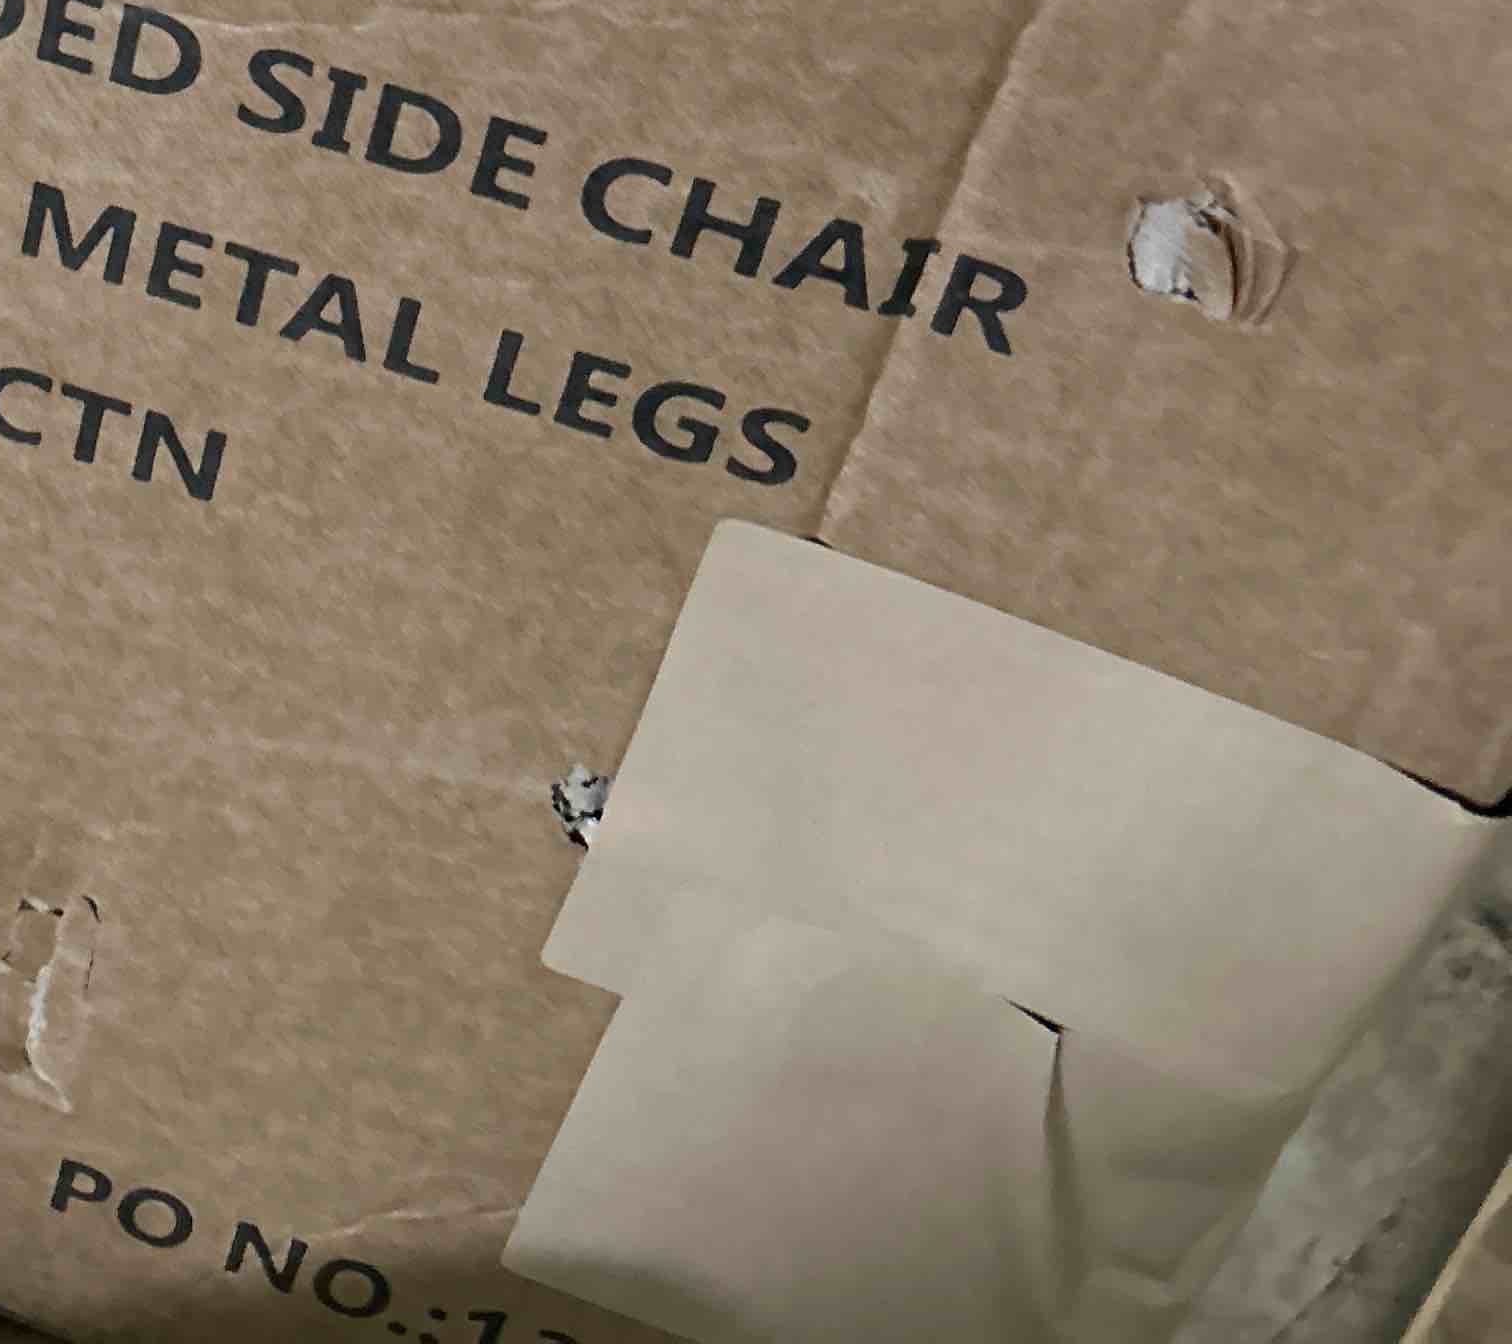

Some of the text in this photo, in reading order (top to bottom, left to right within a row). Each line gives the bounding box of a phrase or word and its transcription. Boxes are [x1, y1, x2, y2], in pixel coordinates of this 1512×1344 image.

[22, 181, 439, 384] METAL
[484, 330, 811, 485] LEGS
[238, 49, 547, 210] SIDE
[581, 158, 1028, 356] CHAIR
[51, 1159, 577, 1344] PO NO.:1
